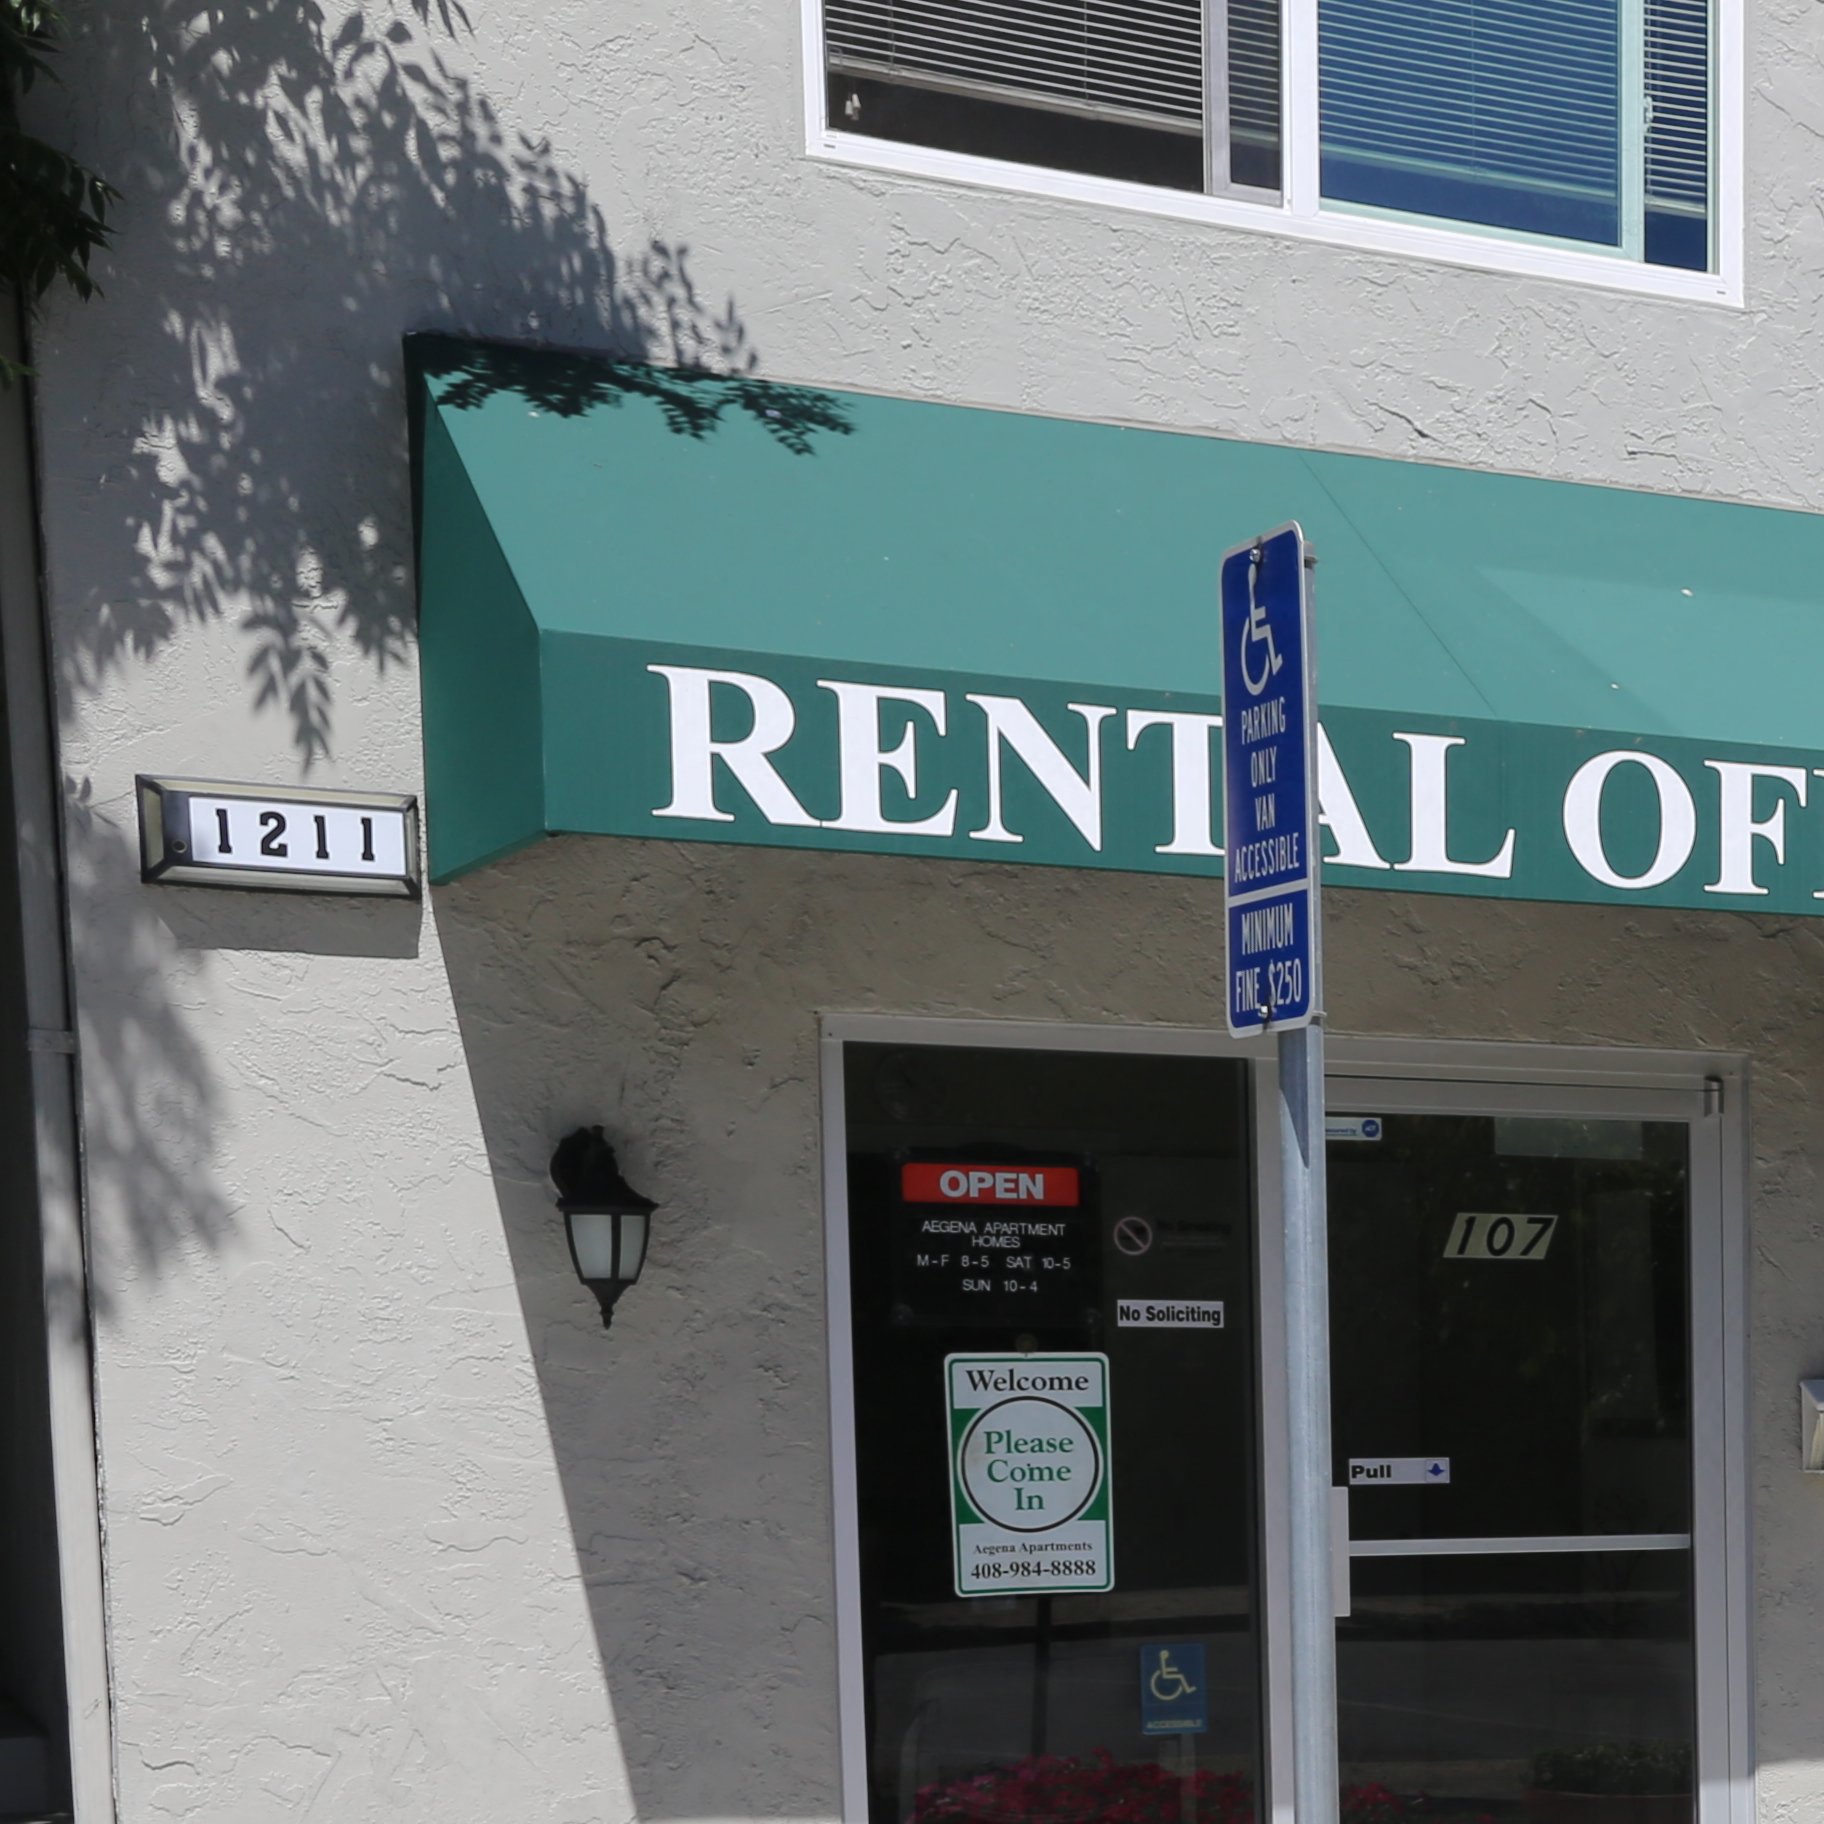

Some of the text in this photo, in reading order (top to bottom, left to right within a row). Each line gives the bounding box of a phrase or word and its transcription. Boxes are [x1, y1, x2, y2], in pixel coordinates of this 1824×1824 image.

[1241, 696, 1286, 745] PARKING
[1250, 746, 1278, 788] ONLY
[1255, 793, 1276, 831] VAN
[215, 808, 376, 862] 1211
[1234, 832, 1300, 884] ACCESSIBLE
[1241, 902, 1294, 956] MINIMUM
[1235, 957, 1303, 1014] FINE $250
[939, 1169, 1045, 1200] OPEN
[921, 1220, 1066, 1236] AEGENA APARTMENT
[1456, 1216, 1555, 1257] 107
[971, 1236, 1021, 1249] HOMES
[1006, 1256, 1032, 1270] SAT
[962, 1279, 991, 1292] SUN
[1119, 1305, 1221, 1326] No Soliciting
[965, 1369, 1089, 1392] Welcome
[984, 1429, 1074, 1455] Please
[987, 1459, 1072, 1484] Come
[1351, 1465, 1392, 1479] Pull
[1014, 1487, 1045, 1511] In
[973, 1541, 1093, 1556] Aegena Apartments
[971, 1559, 1097, 1580] 408-984-8888
